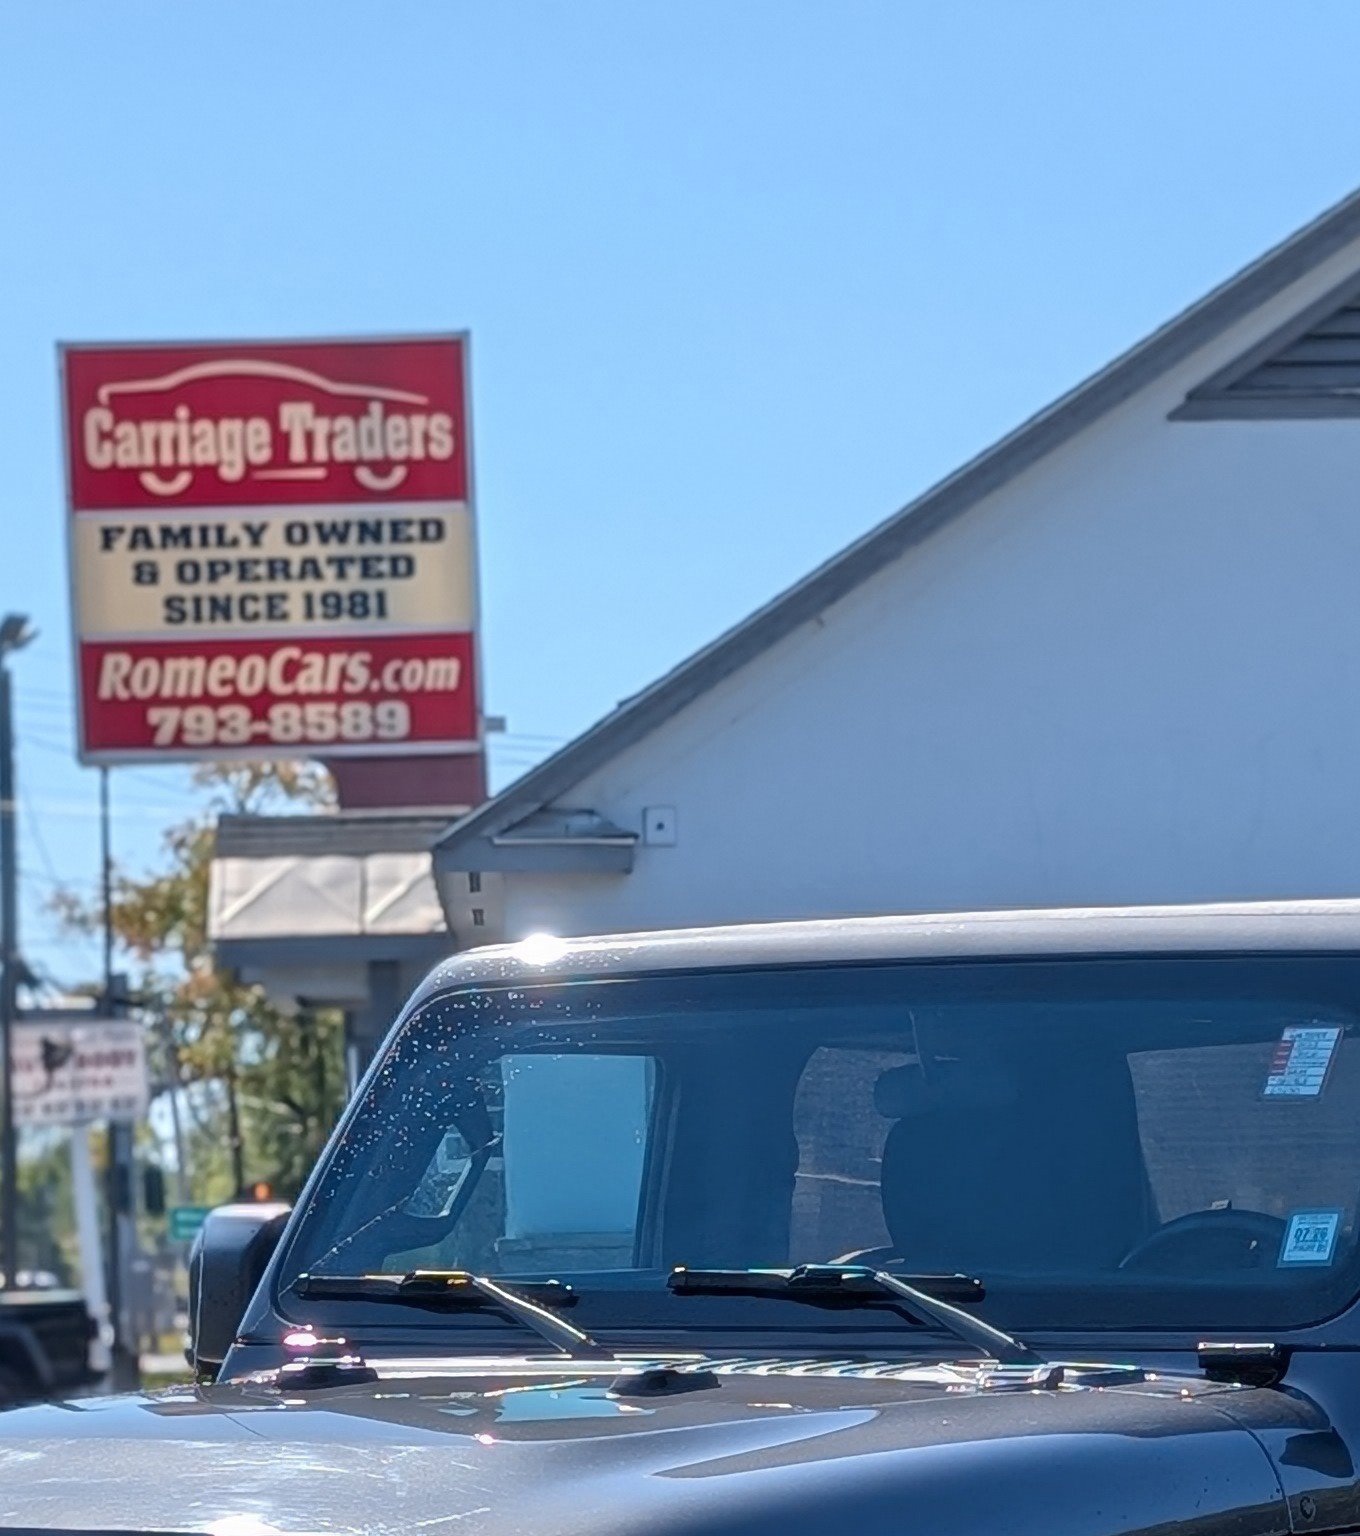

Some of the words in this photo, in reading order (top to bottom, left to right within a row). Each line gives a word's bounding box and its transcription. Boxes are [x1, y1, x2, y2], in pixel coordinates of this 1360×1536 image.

[84, 406, 271, 481] Carriage
[280, 401, 454, 463] Traders
[99, 522, 269, 551] FAMILY
[285, 518, 446, 547] OWNED
[133, 561, 159, 585] &
[177, 555, 416, 584] OPERATED
[164, 594, 289, 624] SINCE
[302, 590, 388, 620] 1981
[99, 647, 460, 700] RomeoCars.com
[147, 700, 412, 746] 793-8589
